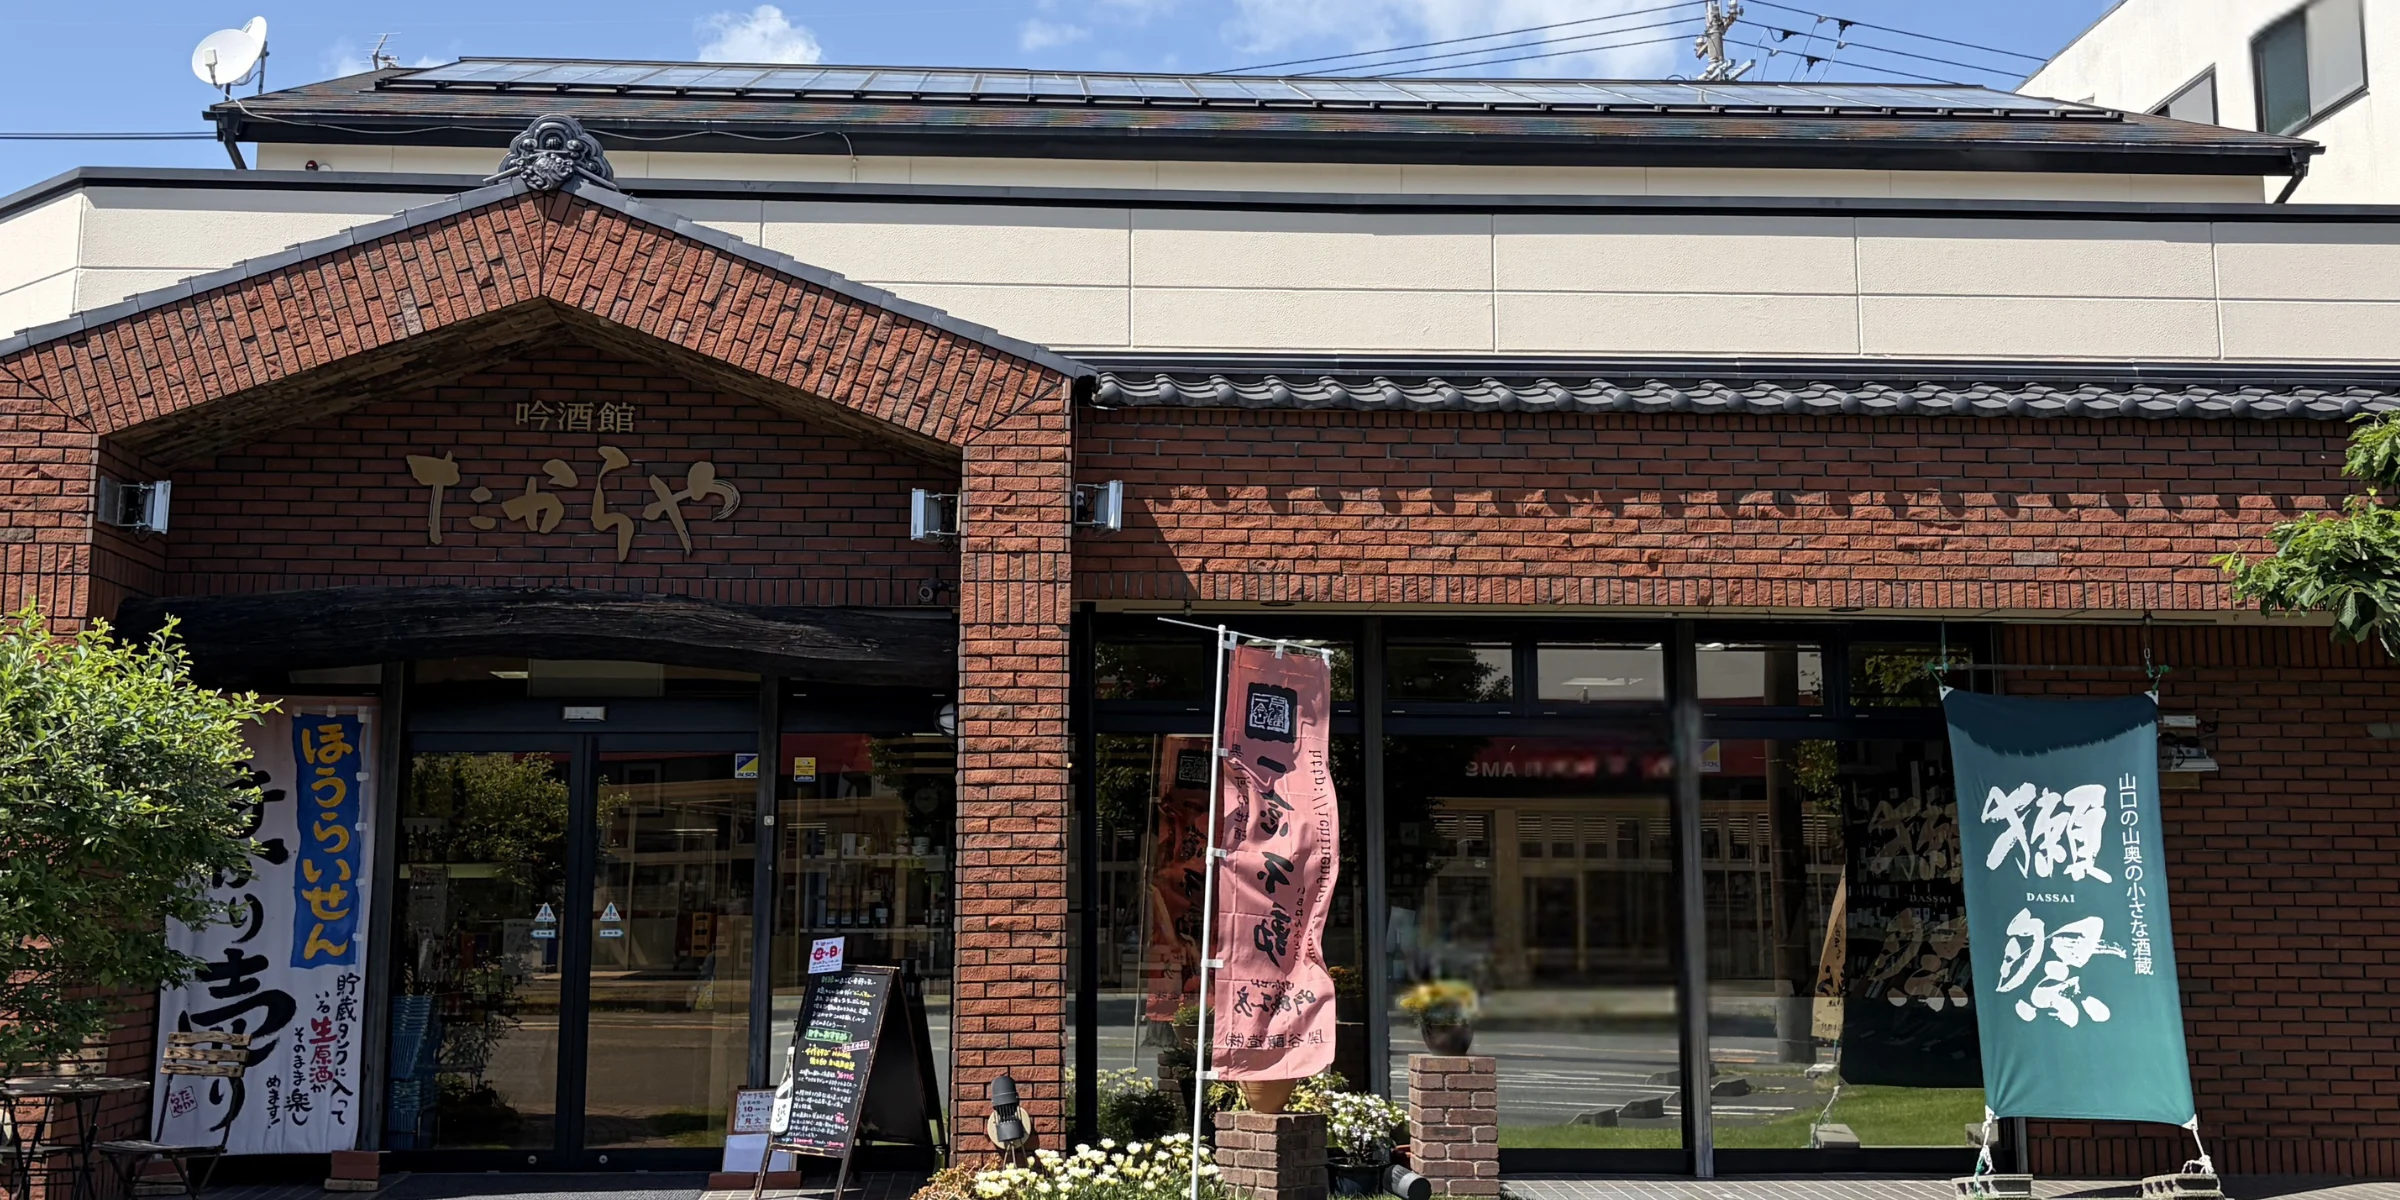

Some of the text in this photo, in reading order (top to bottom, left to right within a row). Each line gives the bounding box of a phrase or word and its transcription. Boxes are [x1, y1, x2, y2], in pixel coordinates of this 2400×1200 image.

[515, 400, 636, 434] 吟酒館
[405, 446, 741, 562] たからや
[300, 722, 353, 961] ほうらいせん
[2026, 892, 2075, 904] DASSAI
[2118, 772, 2154, 976] 山口の山奥の小さな酒蔵
[331, 972, 361, 1125] 貯蔵タンクに入って
